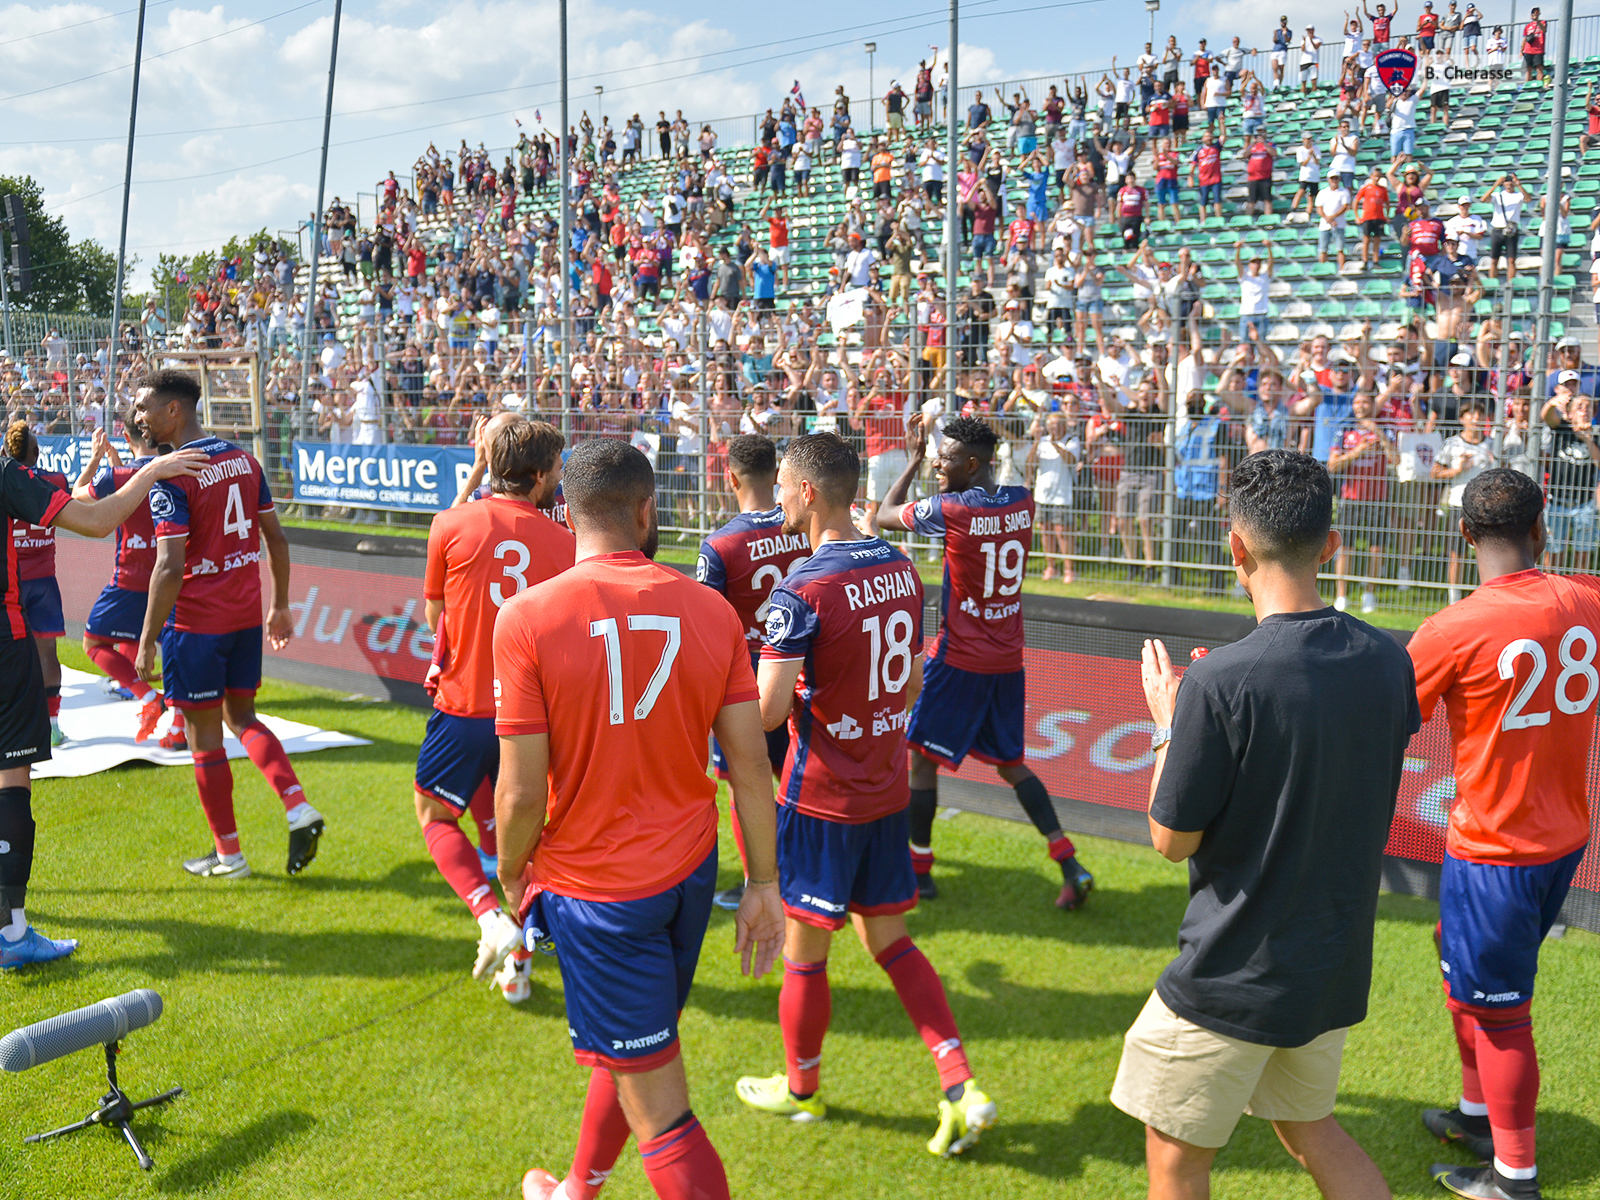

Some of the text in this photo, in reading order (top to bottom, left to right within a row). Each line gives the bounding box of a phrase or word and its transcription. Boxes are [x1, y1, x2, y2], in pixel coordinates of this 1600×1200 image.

[298, 449, 438, 489] Mercure
[300, 484, 378, 501] CLERMONT-FERRAND
[379, 489, 412, 503] CENTRE
[223, 482, 252, 540] 4
[969, 509, 1031, 536] ABDUL SAMED
[489, 539, 531, 608] 3
[979, 539, 1025, 599] 19
[288, 586, 353, 645] du
[589, 614, 682, 726] 17
[862, 609, 914, 702] 18
[1497, 625, 1600, 733] 28
[1485, 990, 1521, 1003] PATRICK
[624, 1027, 670, 1051] PATRICK
